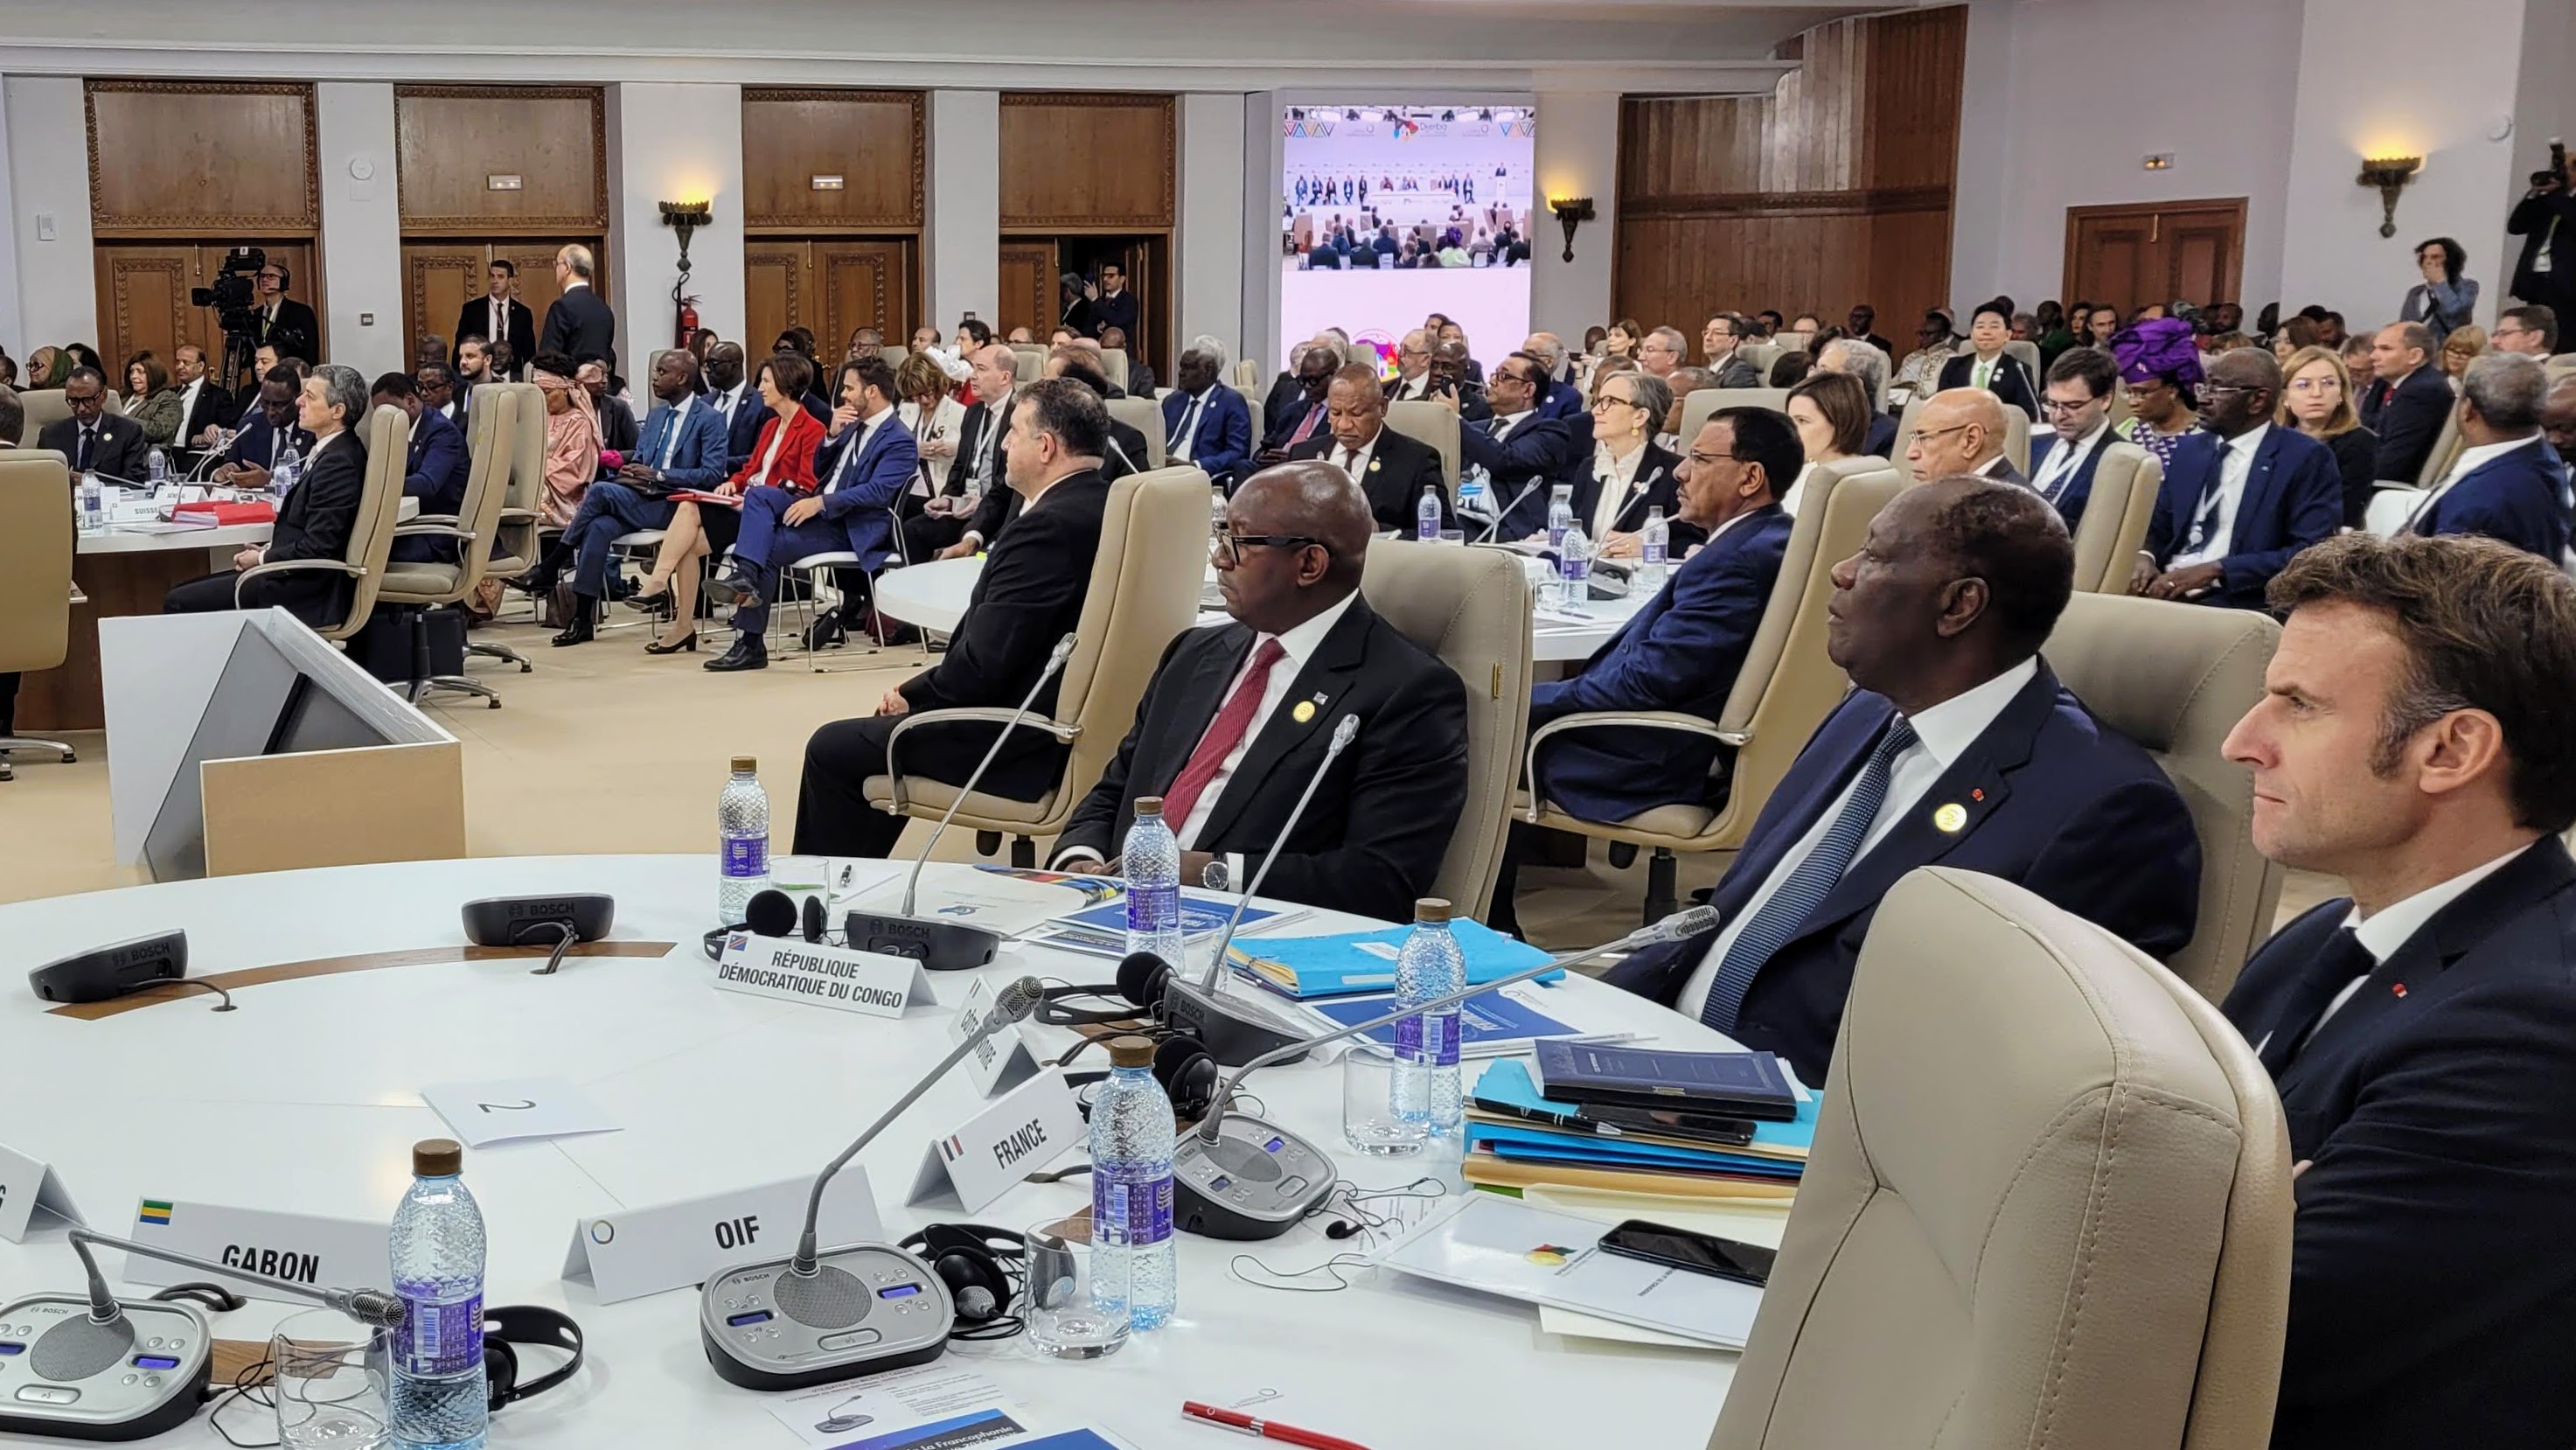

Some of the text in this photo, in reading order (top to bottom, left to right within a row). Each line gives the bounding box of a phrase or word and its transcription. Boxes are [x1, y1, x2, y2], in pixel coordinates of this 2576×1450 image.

[529, 903, 574, 916] BOSCH
[888, 924, 930, 938] BOSCH
[131, 943, 171, 961] BOSCH
[771, 950, 860, 979] RÉPUBLIQUE
[719, 964, 902, 1008] DÉMOCRATIQUE DU CONGO
[1180, 1000, 1205, 1023] BOSCH
[477, 1099, 536, 1113] 2
[992, 1119, 1048, 1170] FRANCE
[715, 1215, 760, 1250] OIF
[221, 1244, 319, 1284] GABON
[743, 1273, 770, 1282] BOSCH
[935, 1426, 1014, 1448] Francophonie
